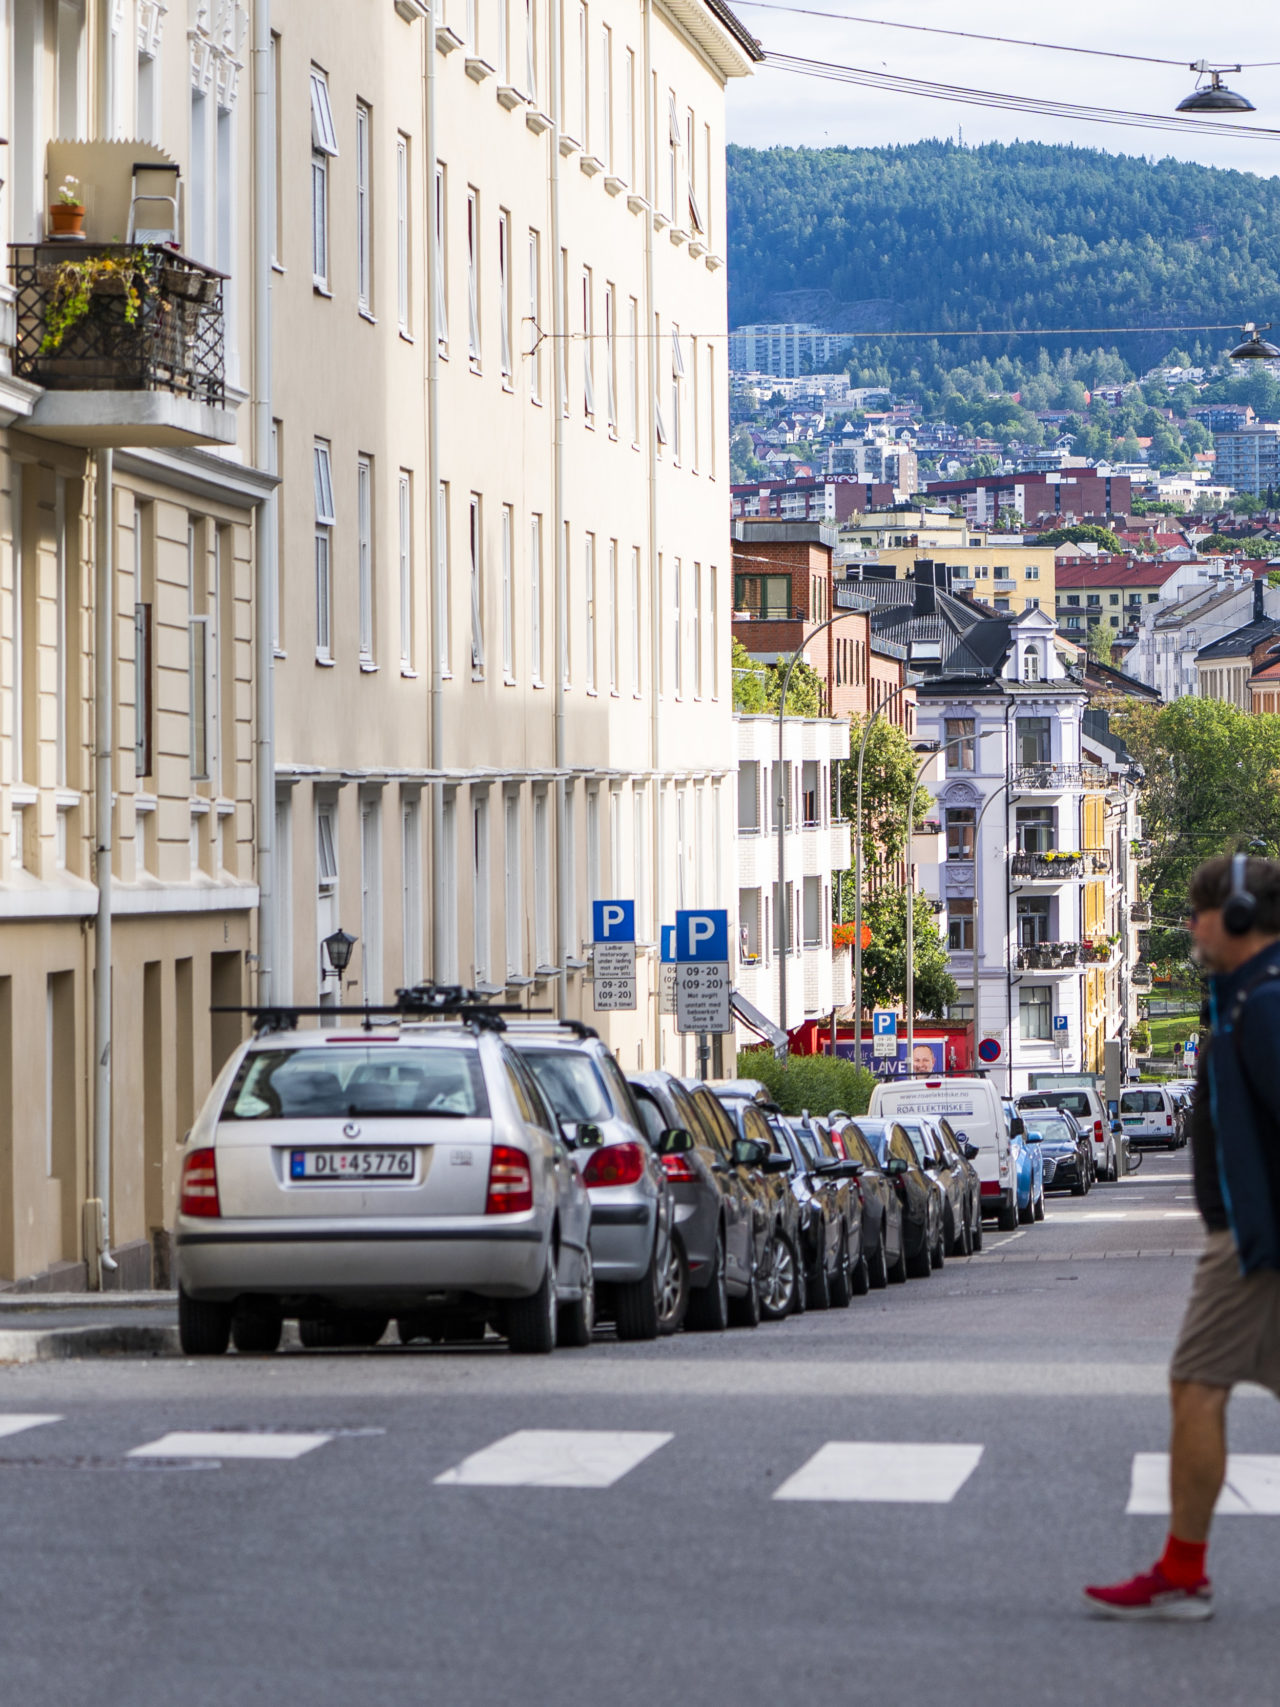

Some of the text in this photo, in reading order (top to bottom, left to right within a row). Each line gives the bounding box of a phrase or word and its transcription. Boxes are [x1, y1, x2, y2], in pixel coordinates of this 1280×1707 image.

[603, 905, 625, 937] P
[688, 916, 715, 956] P
[878, 1015, 891, 1033] P
[1057, 1017, 1065, 1029] P
[1186, 1043, 1193, 1051] P
[917, 1103, 962, 1113] ELEKTRISKE
[315, 1153, 409, 1173] DL 45776
